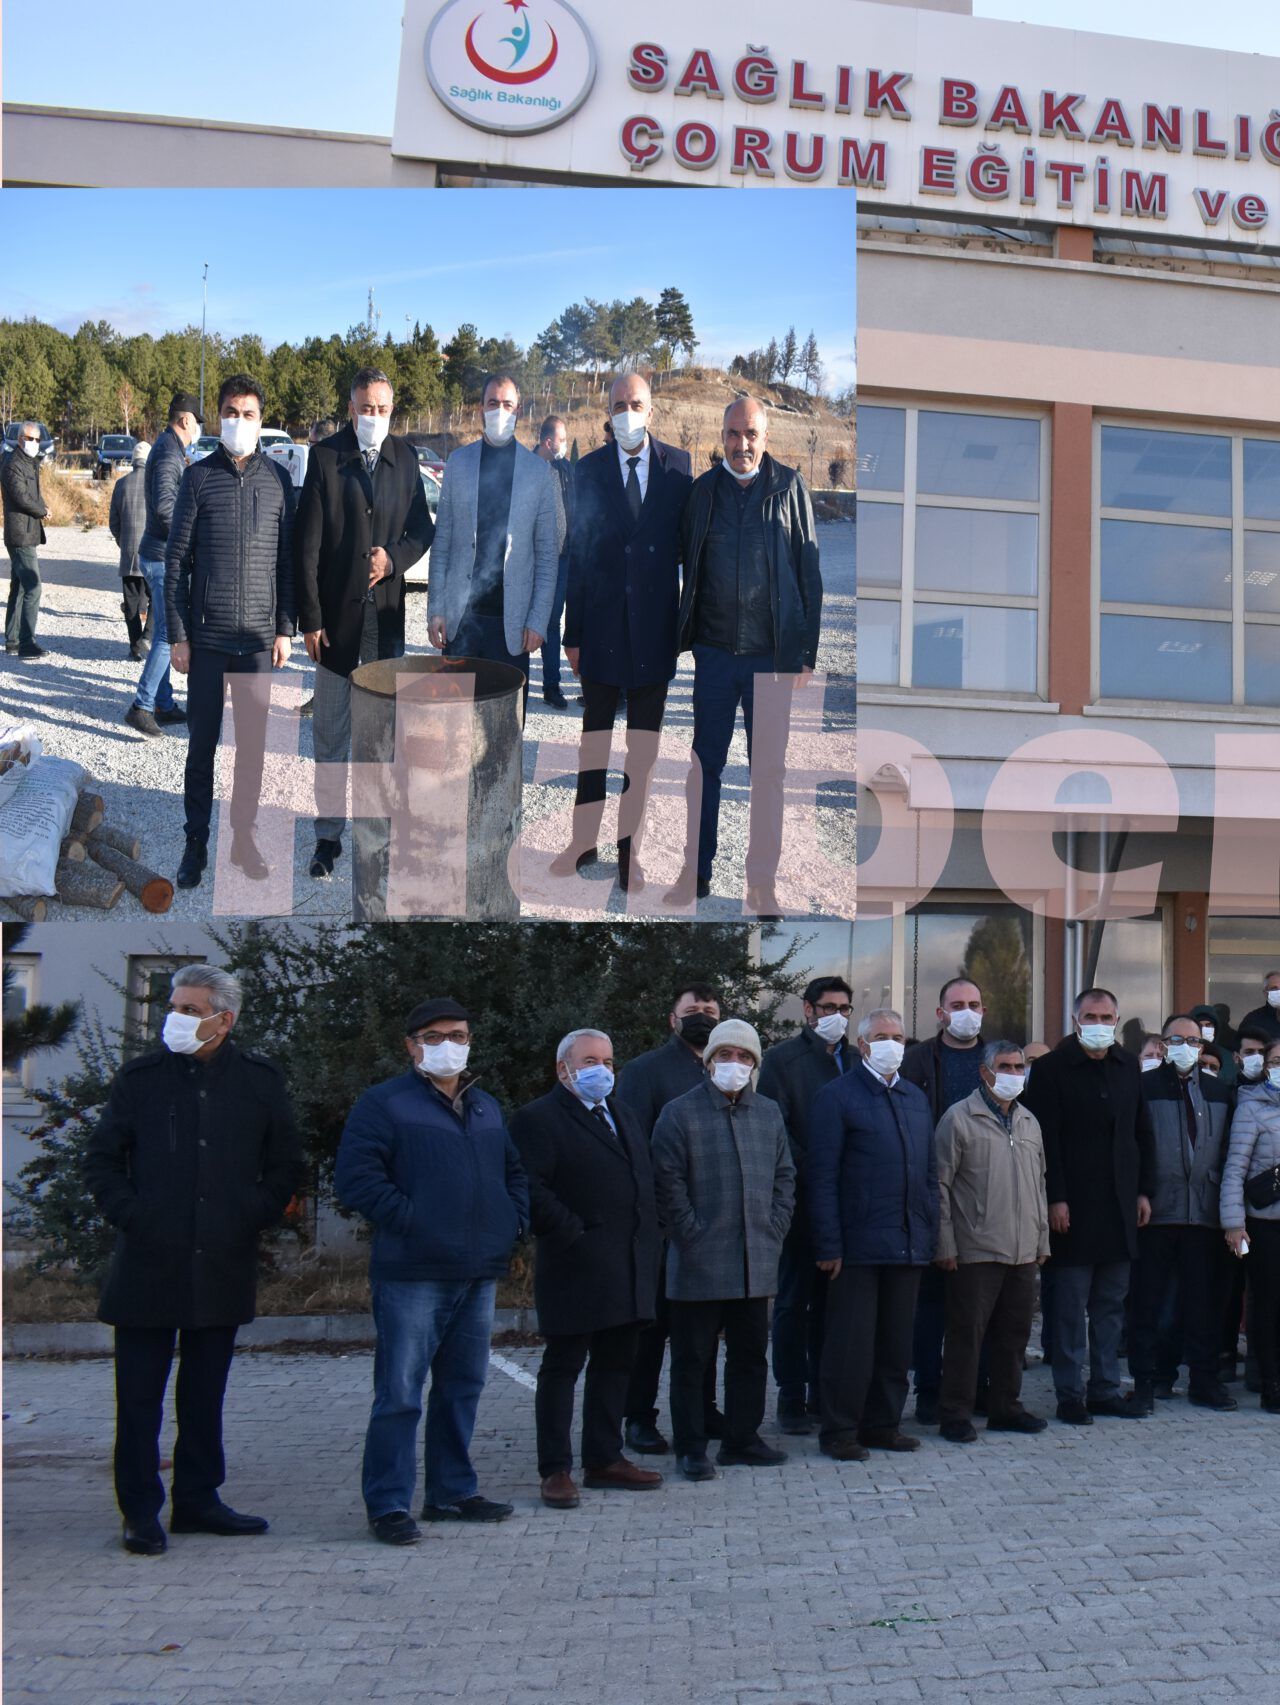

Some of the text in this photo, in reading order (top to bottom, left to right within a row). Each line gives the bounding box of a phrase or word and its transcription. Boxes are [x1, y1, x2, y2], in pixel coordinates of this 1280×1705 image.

[450, 86, 561, 111] Sağlık Bakanlığı
[627, 41, 911, 121] SAĞLIK
[620, 115, 887, 190] ÇORUM
[919, 142, 1168, 221] EĞİTİM
[1192, 187, 1269, 230] ve
